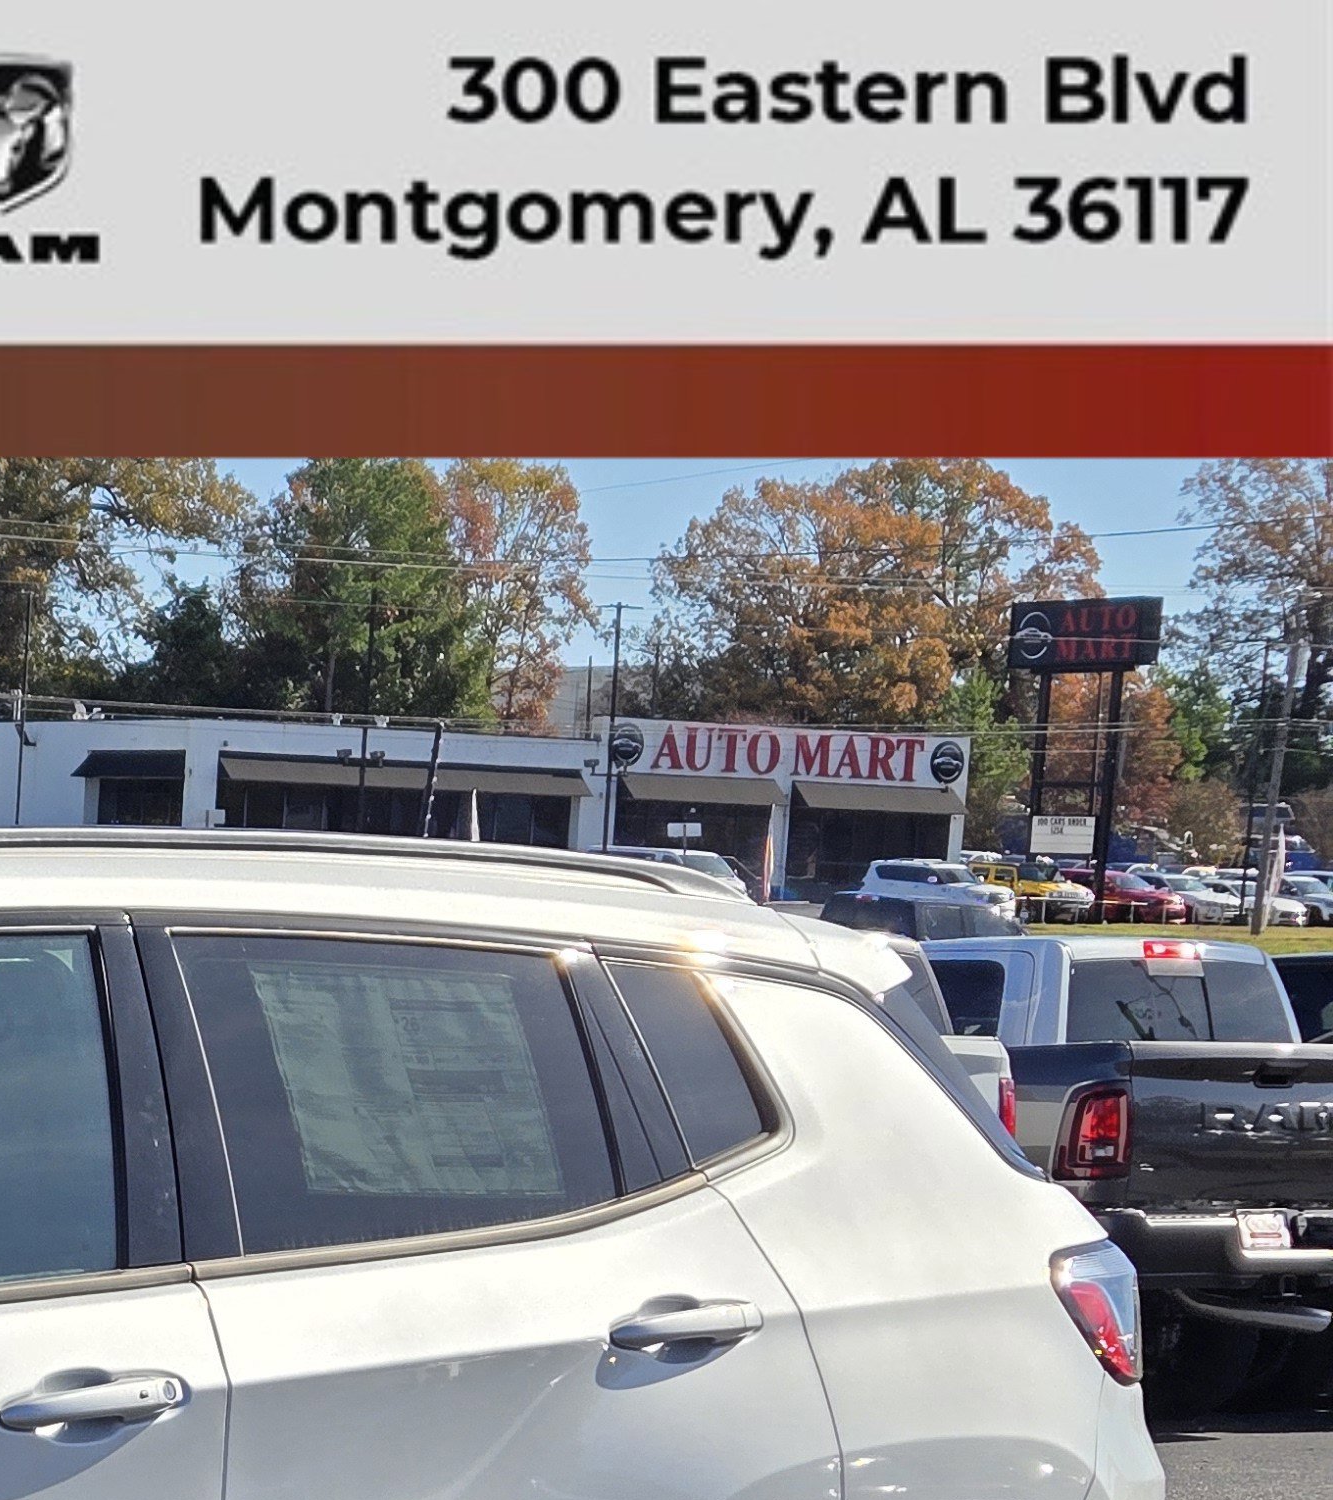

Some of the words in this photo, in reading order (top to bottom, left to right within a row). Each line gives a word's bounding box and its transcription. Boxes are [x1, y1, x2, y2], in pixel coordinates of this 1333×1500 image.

[1061, 604, 1137, 632] AUTO
[1057, 634, 1137, 661] MART
[650, 724, 782, 775] AUTO
[790, 734, 925, 781] MART
